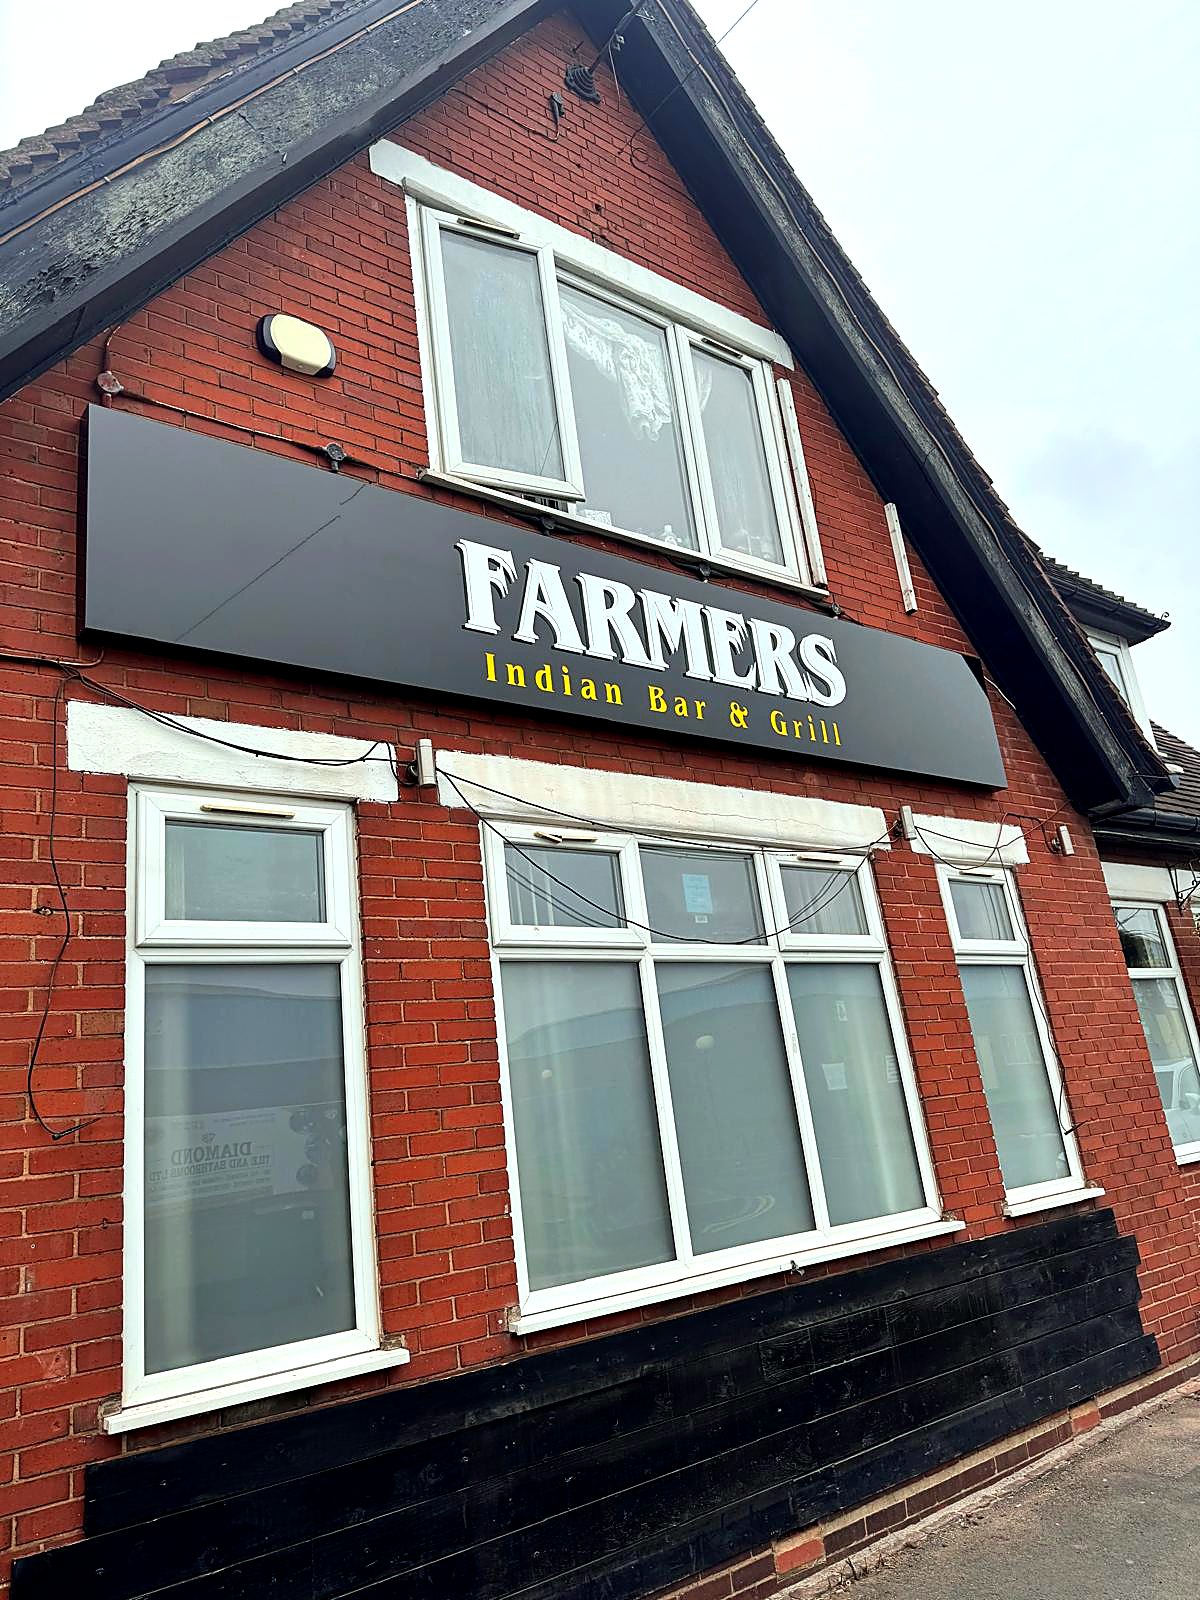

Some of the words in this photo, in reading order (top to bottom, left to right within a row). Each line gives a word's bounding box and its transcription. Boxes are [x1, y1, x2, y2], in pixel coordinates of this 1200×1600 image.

[454, 538, 847, 708] FARMERS
[484, 652, 623, 706] Indian
[648, 685, 706, 720] Bar
[729, 702, 749, 729] &
[769, 710, 842, 746] Grill
